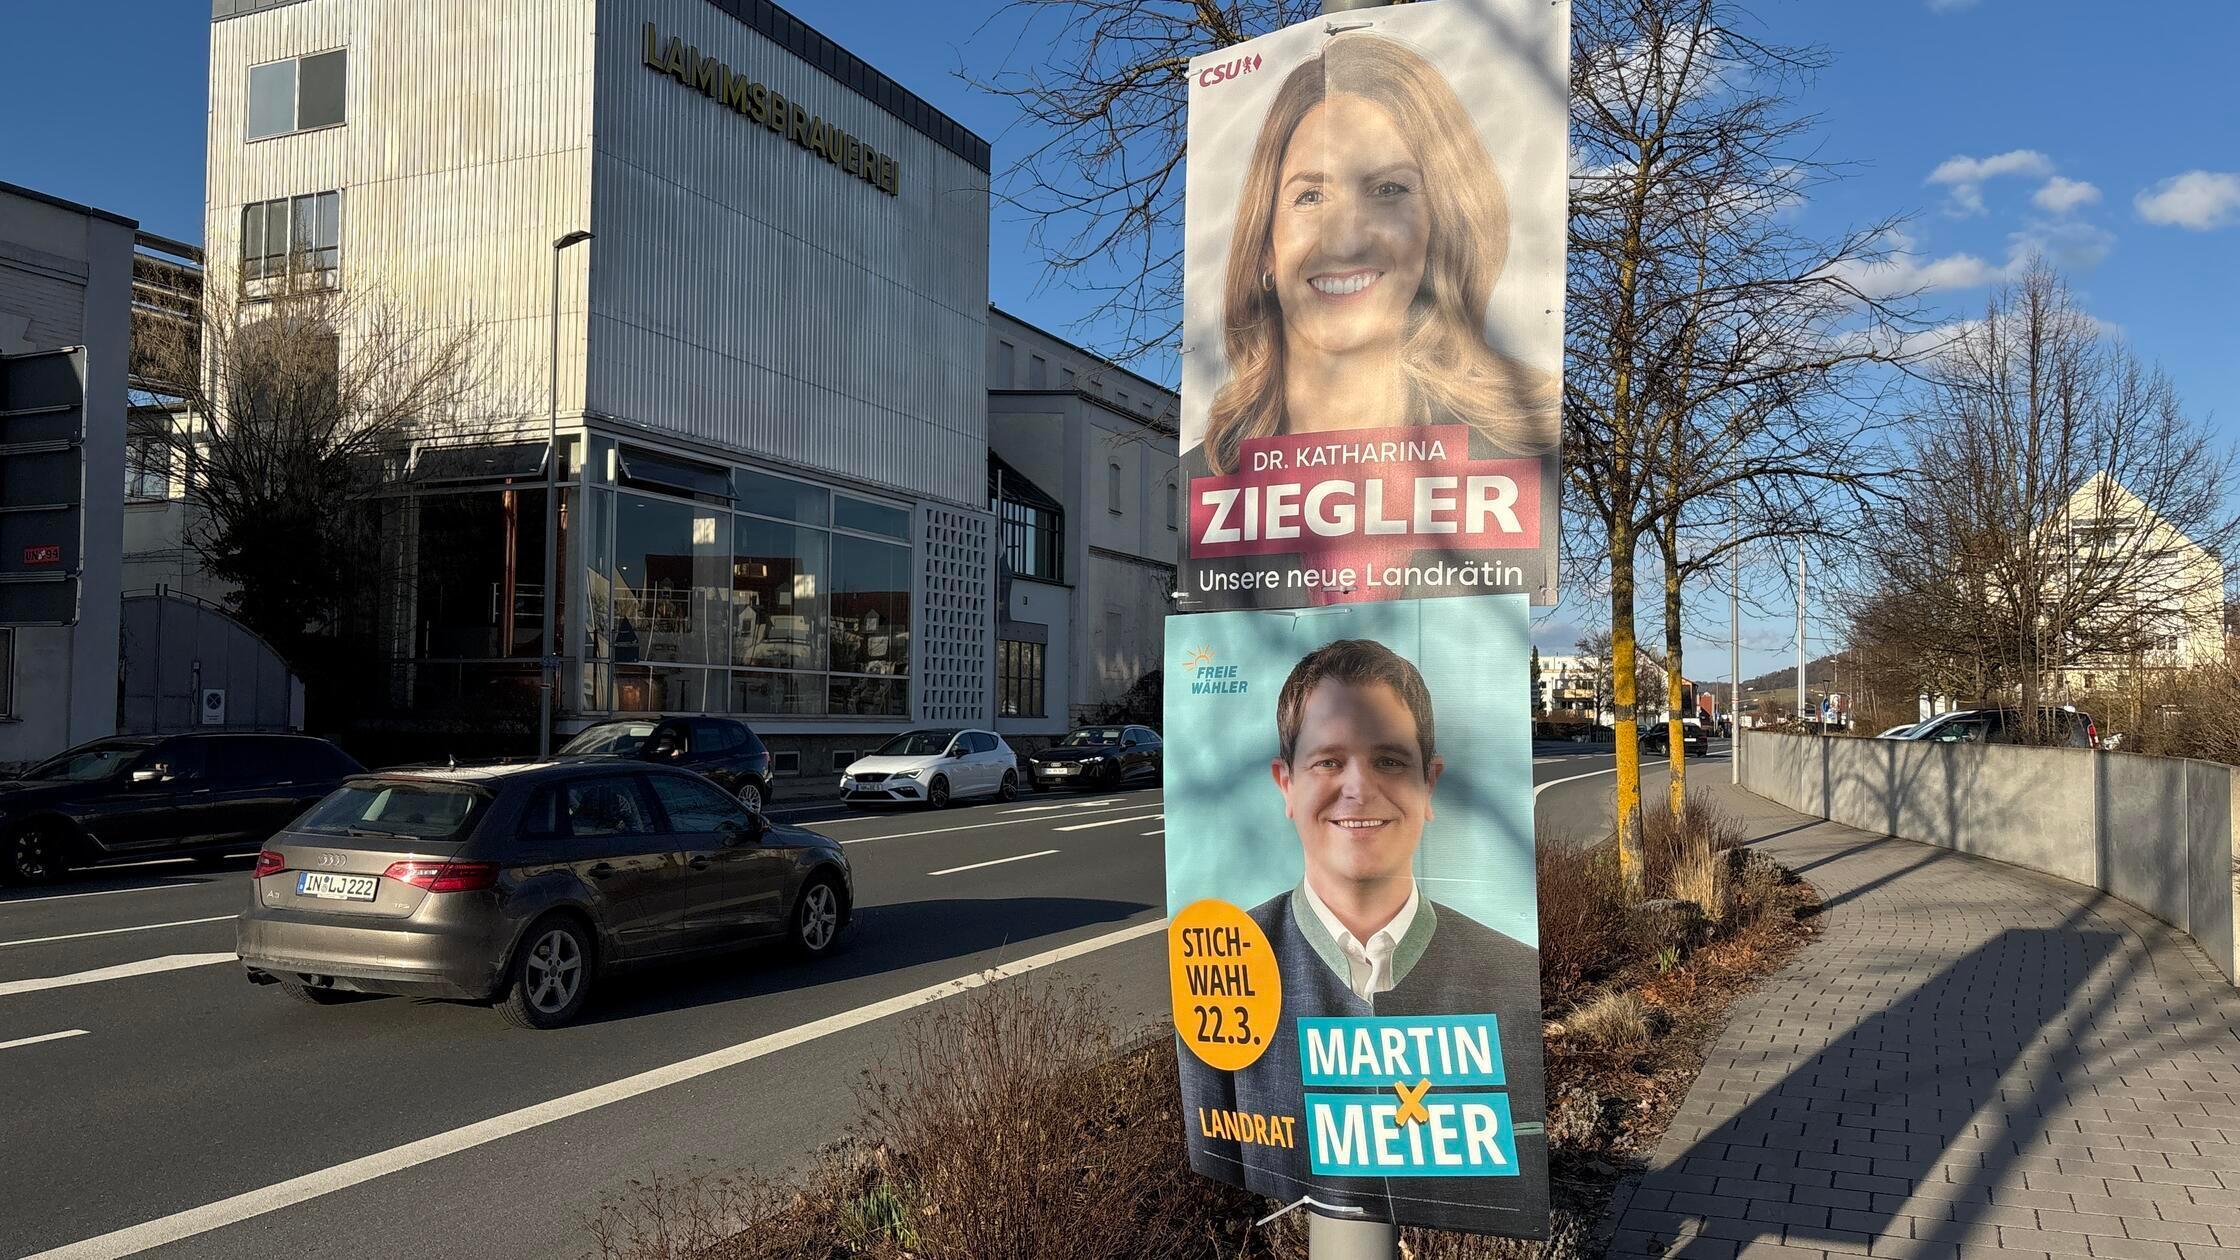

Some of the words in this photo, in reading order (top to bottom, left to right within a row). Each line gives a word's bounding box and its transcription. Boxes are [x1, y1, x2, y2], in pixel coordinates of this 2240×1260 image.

[1199, 59, 1242, 87] CSU
[643, 21, 899, 196] LAMMSBRAUEREI
[1254, 450, 1289, 471] DR.
[1296, 440, 1447, 467] KATHARINA
[1200, 475, 1523, 545] ZIEGLER
[1200, 569, 1280, 591] Unsere
[1287, 569, 1357, 587] neue
[1367, 560, 1523, 587] Landrätin
[1191, 680, 1248, 695] WÄHLER
[1197, 666, 1238, 679] FREIE
[306, 875, 322, 892] IN
[328, 877, 347, 893] LJ
[347, 879, 374, 896] 222
[1182, 927, 1251, 957] STICH-
[1186, 965, 1256, 996] WAHL
[1194, 1005, 1261, 1045] 22.3.
[1306, 1026, 1493, 1076] MARTIN
[1199, 1107, 1295, 1149] LANDRAT
[1314, 1103, 1508, 1166] MEIER
